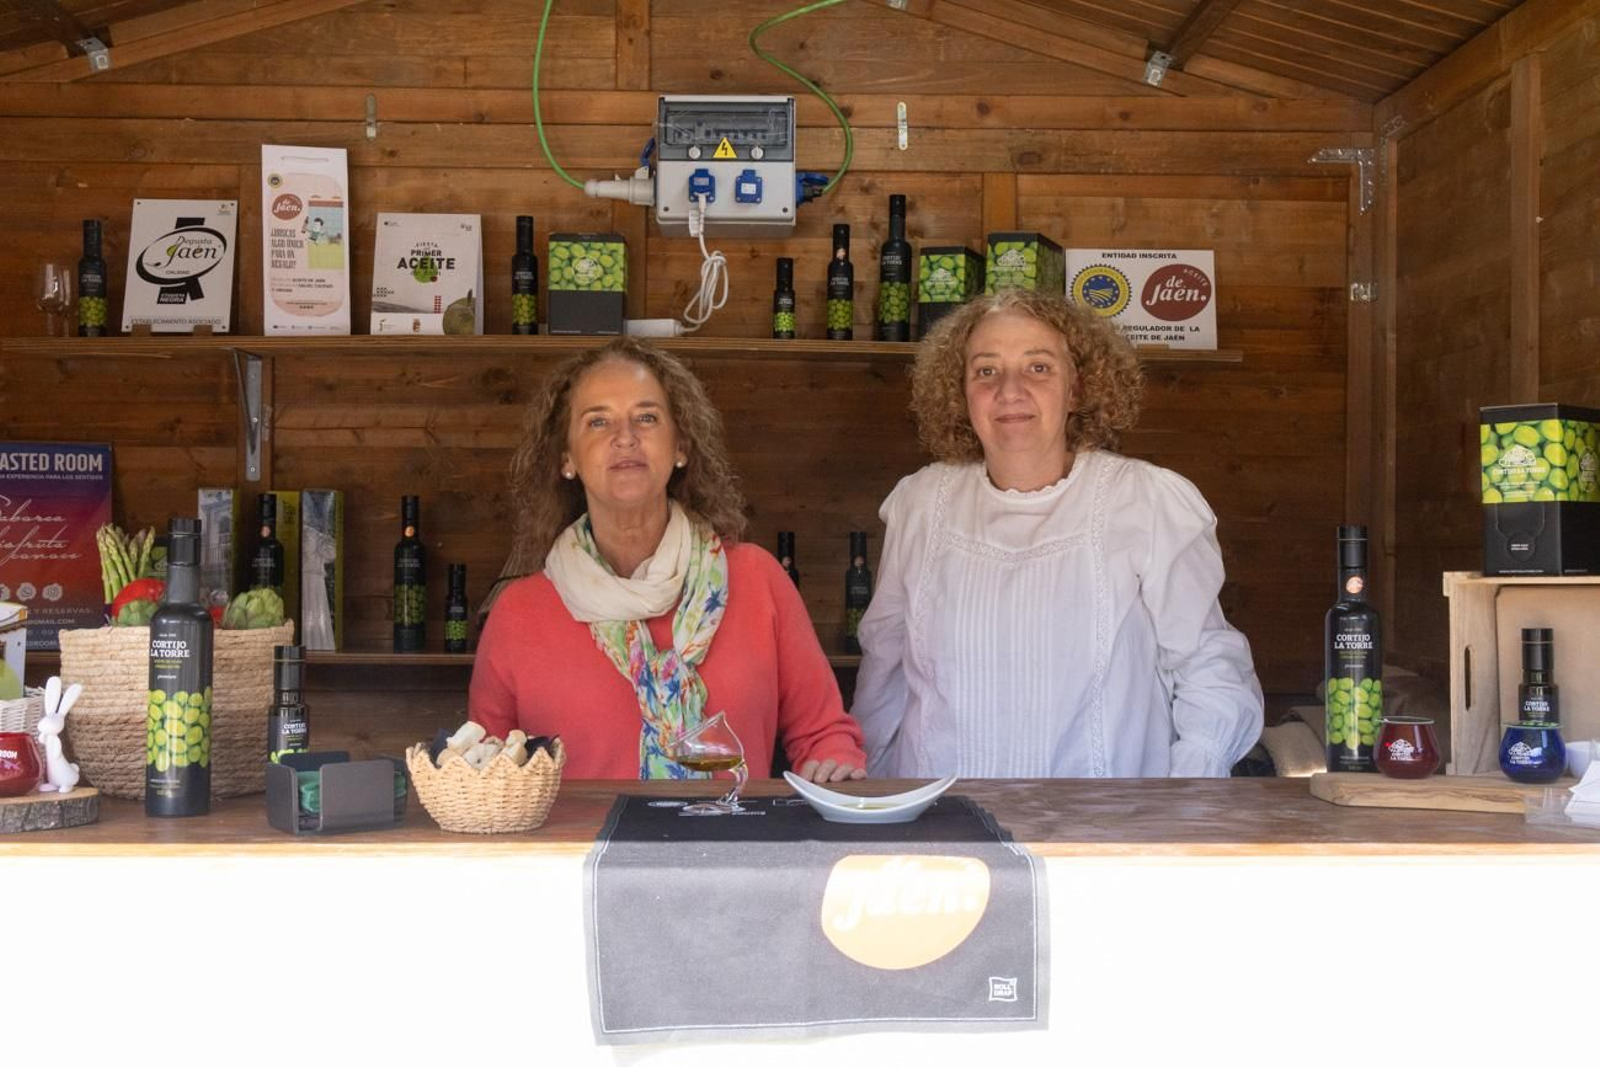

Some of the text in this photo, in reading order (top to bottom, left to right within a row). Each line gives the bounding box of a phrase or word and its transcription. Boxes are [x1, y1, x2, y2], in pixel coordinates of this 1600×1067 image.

[410, 249, 442, 257] PRIMER
[397, 257, 455, 270] ACEITE
[1166, 275, 1182, 288] de
[54, 453, 103, 472] ROOM
[1336, 634, 1371, 642] CORTIJO
[152, 640, 187, 650] CORTIJO
[1334, 641, 1373, 649] LA TORRE
[150, 648, 190, 658] LA TORRE
